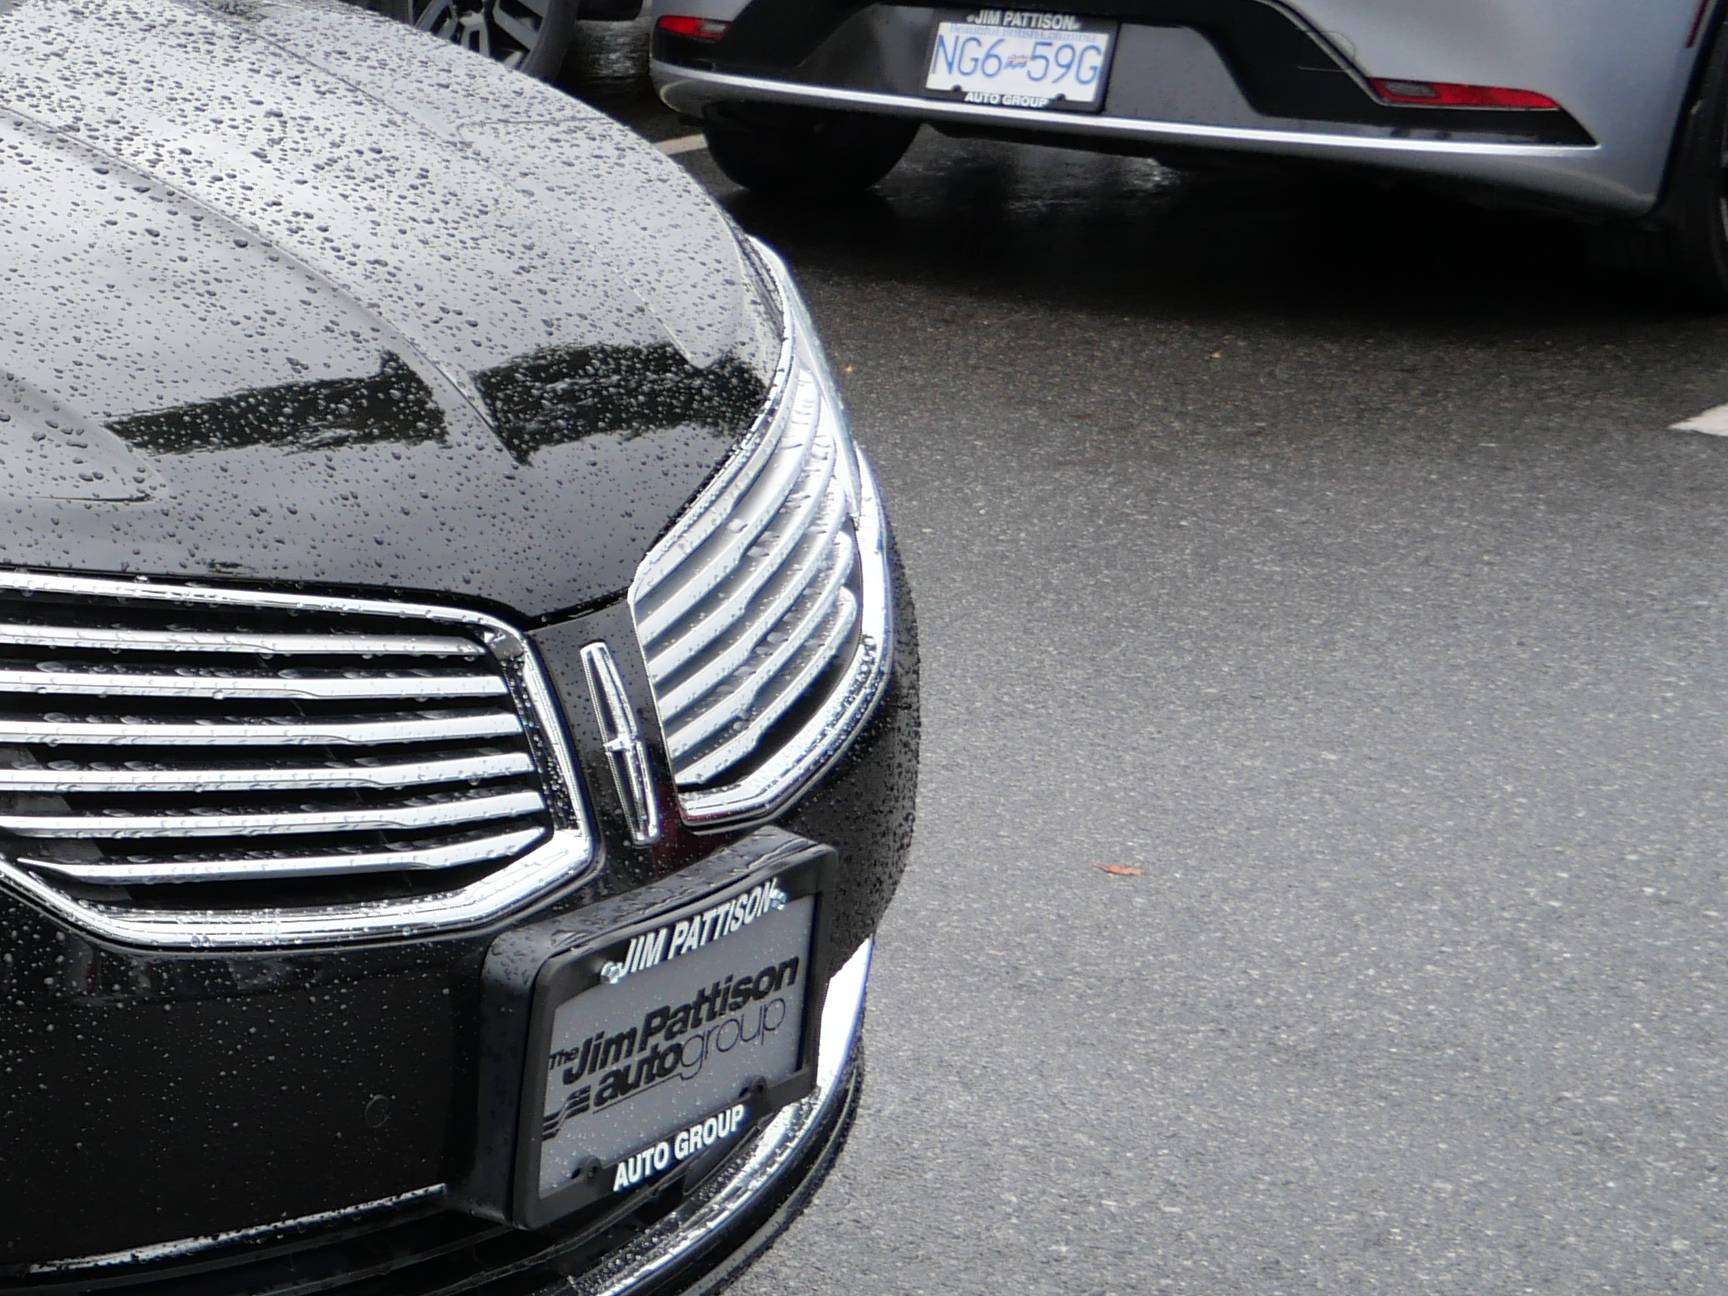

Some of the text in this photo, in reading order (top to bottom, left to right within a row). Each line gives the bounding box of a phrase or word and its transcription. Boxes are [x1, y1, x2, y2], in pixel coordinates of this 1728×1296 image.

[974, 10, 1076, 30] JIM PATTISON
[964, 91, 1050, 108] AUTO GROUP
[619, 877, 779, 977] JIM PATTISON
[548, 1046, 580, 1072] The
[613, 1104, 746, 1192] AUTO GROUP
